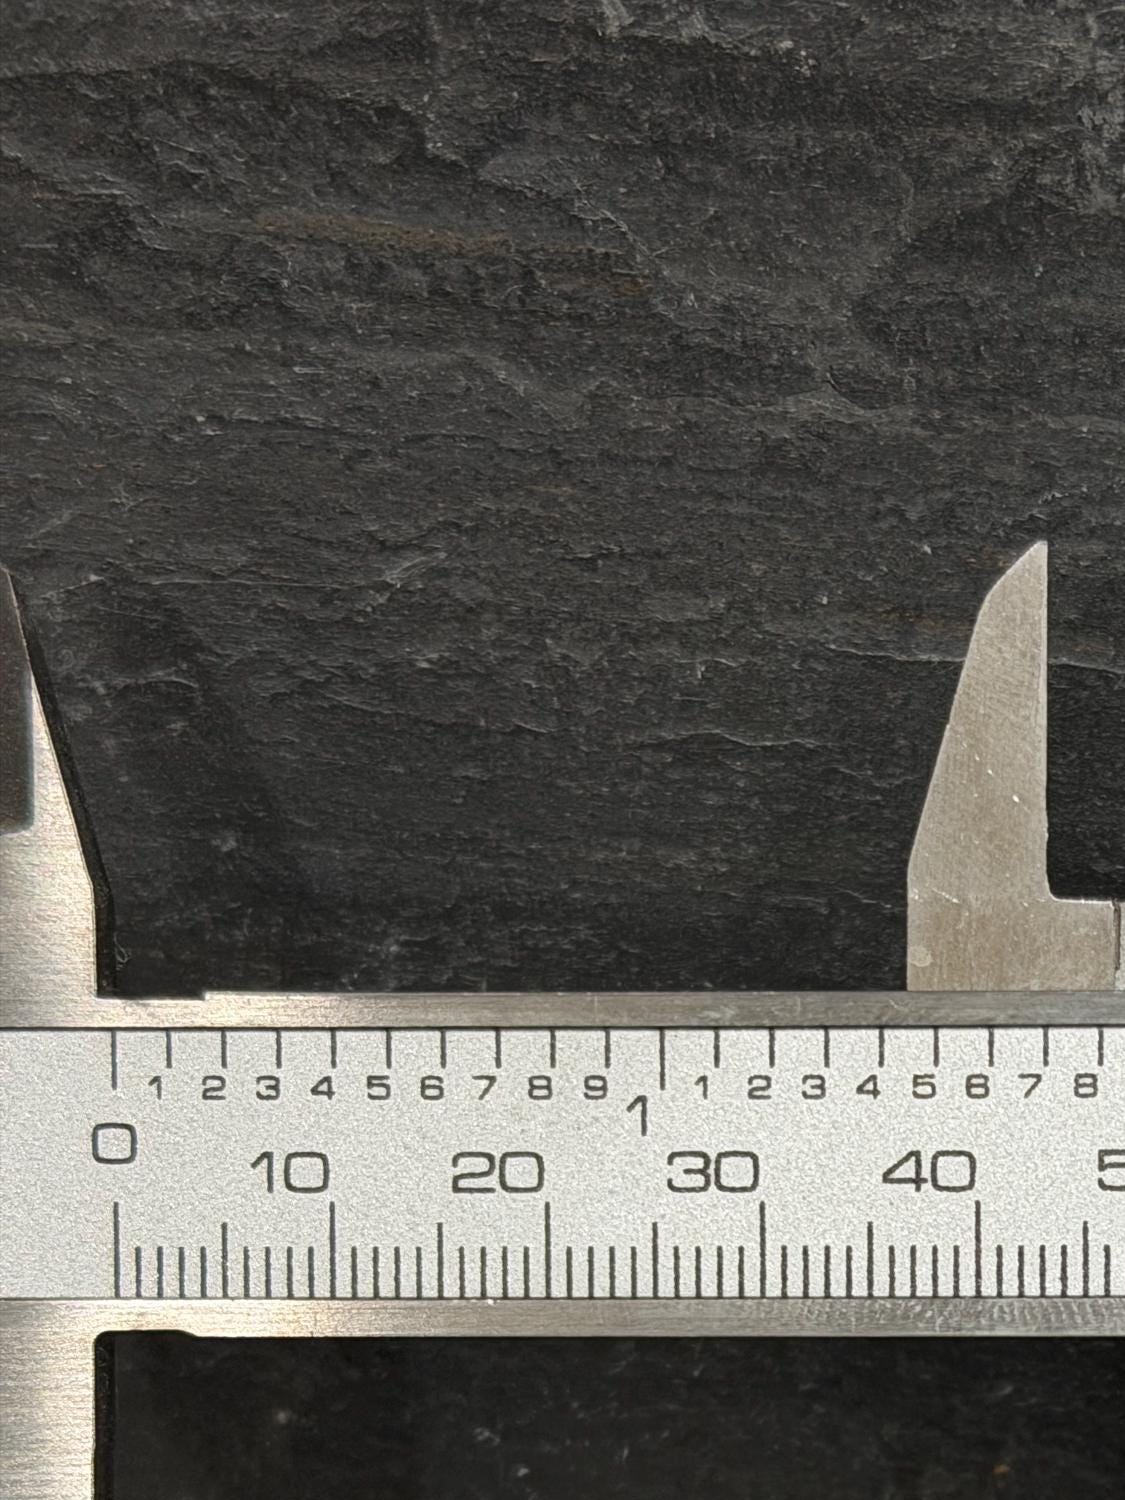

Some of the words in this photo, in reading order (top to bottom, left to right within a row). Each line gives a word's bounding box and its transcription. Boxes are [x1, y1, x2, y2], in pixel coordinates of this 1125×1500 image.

[147, 1075, 163, 1100] 1
[202, 1075, 226, 1100] 2
[256, 1075, 281, 1100] 3
[310, 1075, 335, 1100] 4
[366, 1075, 391, 1100] 5
[420, 1075, 444, 1100] 6
[474, 1075, 497, 1100] 7
[528, 1075, 553, 1100] 8
[583, 1075, 608, 1100] 9
[694, 1075, 709, 1100] 1
[747, 1075, 772, 1100] 2
[801, 1075, 826, 1099] 3
[856, 1074, 881, 1099] 4
[911, 1074, 936, 1099] 5
[965, 1074, 990, 1099] 6
[1018, 1073, 1043, 1098] 7
[1073, 1073, 1098, 1098] 8
[92, 1123, 137, 1164] 0
[626, 1095, 648, 1136] 1
[251, 1151, 330, 1193] 10
[452, 1151, 544, 1193] 20
[667, 1150, 760, 1193] 30
[882, 1150, 976, 1193] 40
